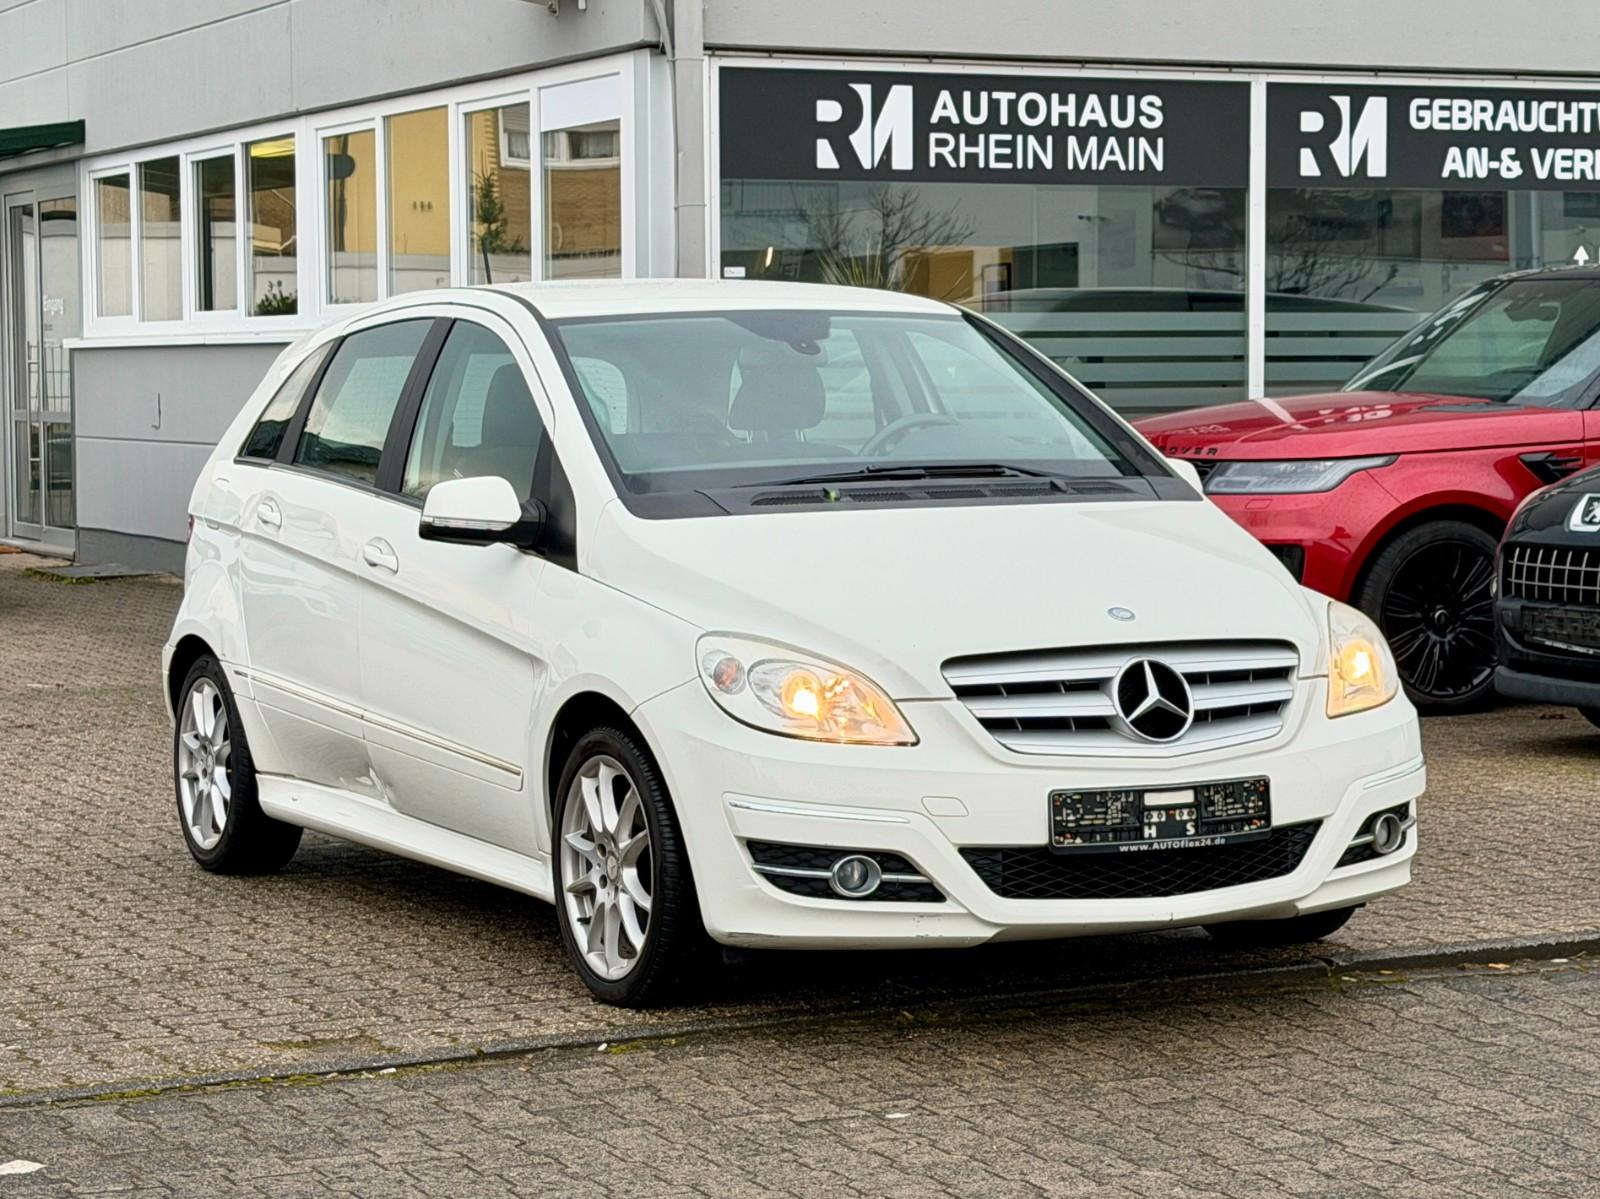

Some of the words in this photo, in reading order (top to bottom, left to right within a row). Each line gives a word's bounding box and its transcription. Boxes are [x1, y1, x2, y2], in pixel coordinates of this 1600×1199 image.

[930, 90, 1164, 129] AUTOHAUS
[1409, 97, 1600, 134] GEBRAUCHT
[928, 131, 1054, 170] RHEIN
[1067, 135, 1165, 172] MAIN
[1530, 147, 1600, 181] VER
[1120, 838, 1226, 852] www.AUTOflex24.de
[1186, 822, 1196, 835] S
